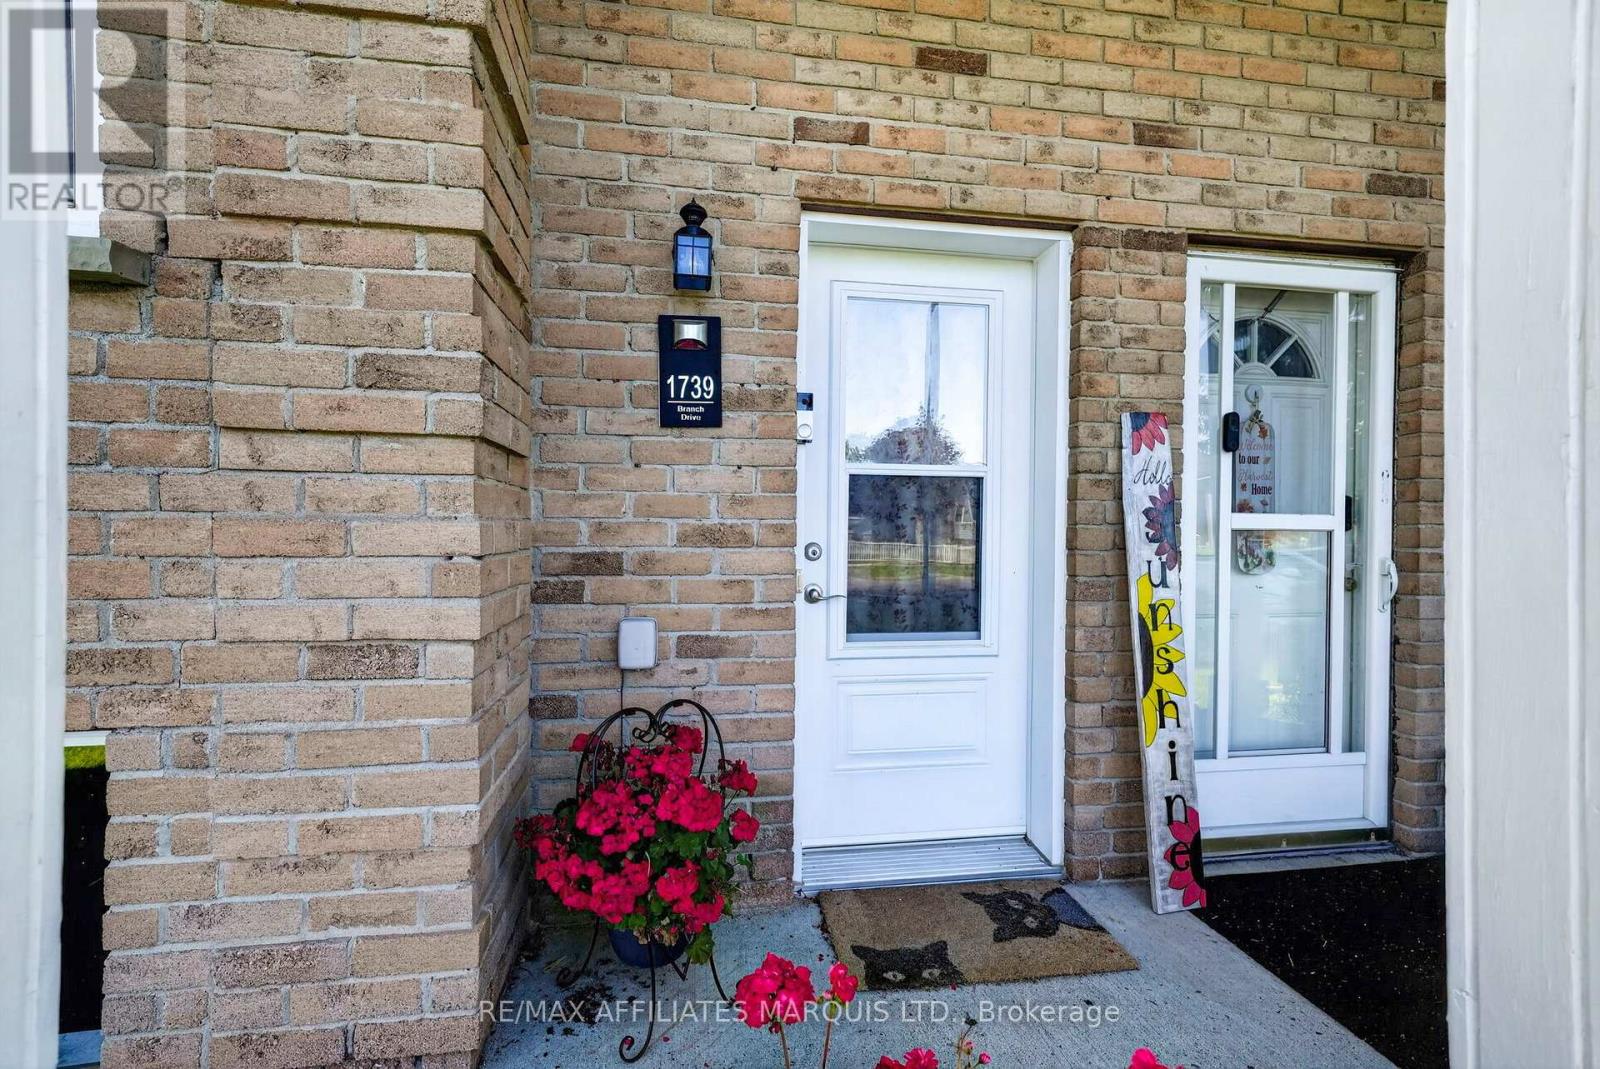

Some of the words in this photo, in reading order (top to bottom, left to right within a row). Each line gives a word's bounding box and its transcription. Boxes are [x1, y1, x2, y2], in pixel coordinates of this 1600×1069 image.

[666, 374, 714, 399] 1739
[677, 405, 705, 413] Branch
[680, 413, 702, 421] Drive
[1238, 453, 1246, 464] to
[1247, 455, 1260, 464] our
[1251, 483, 1273, 495] Home
